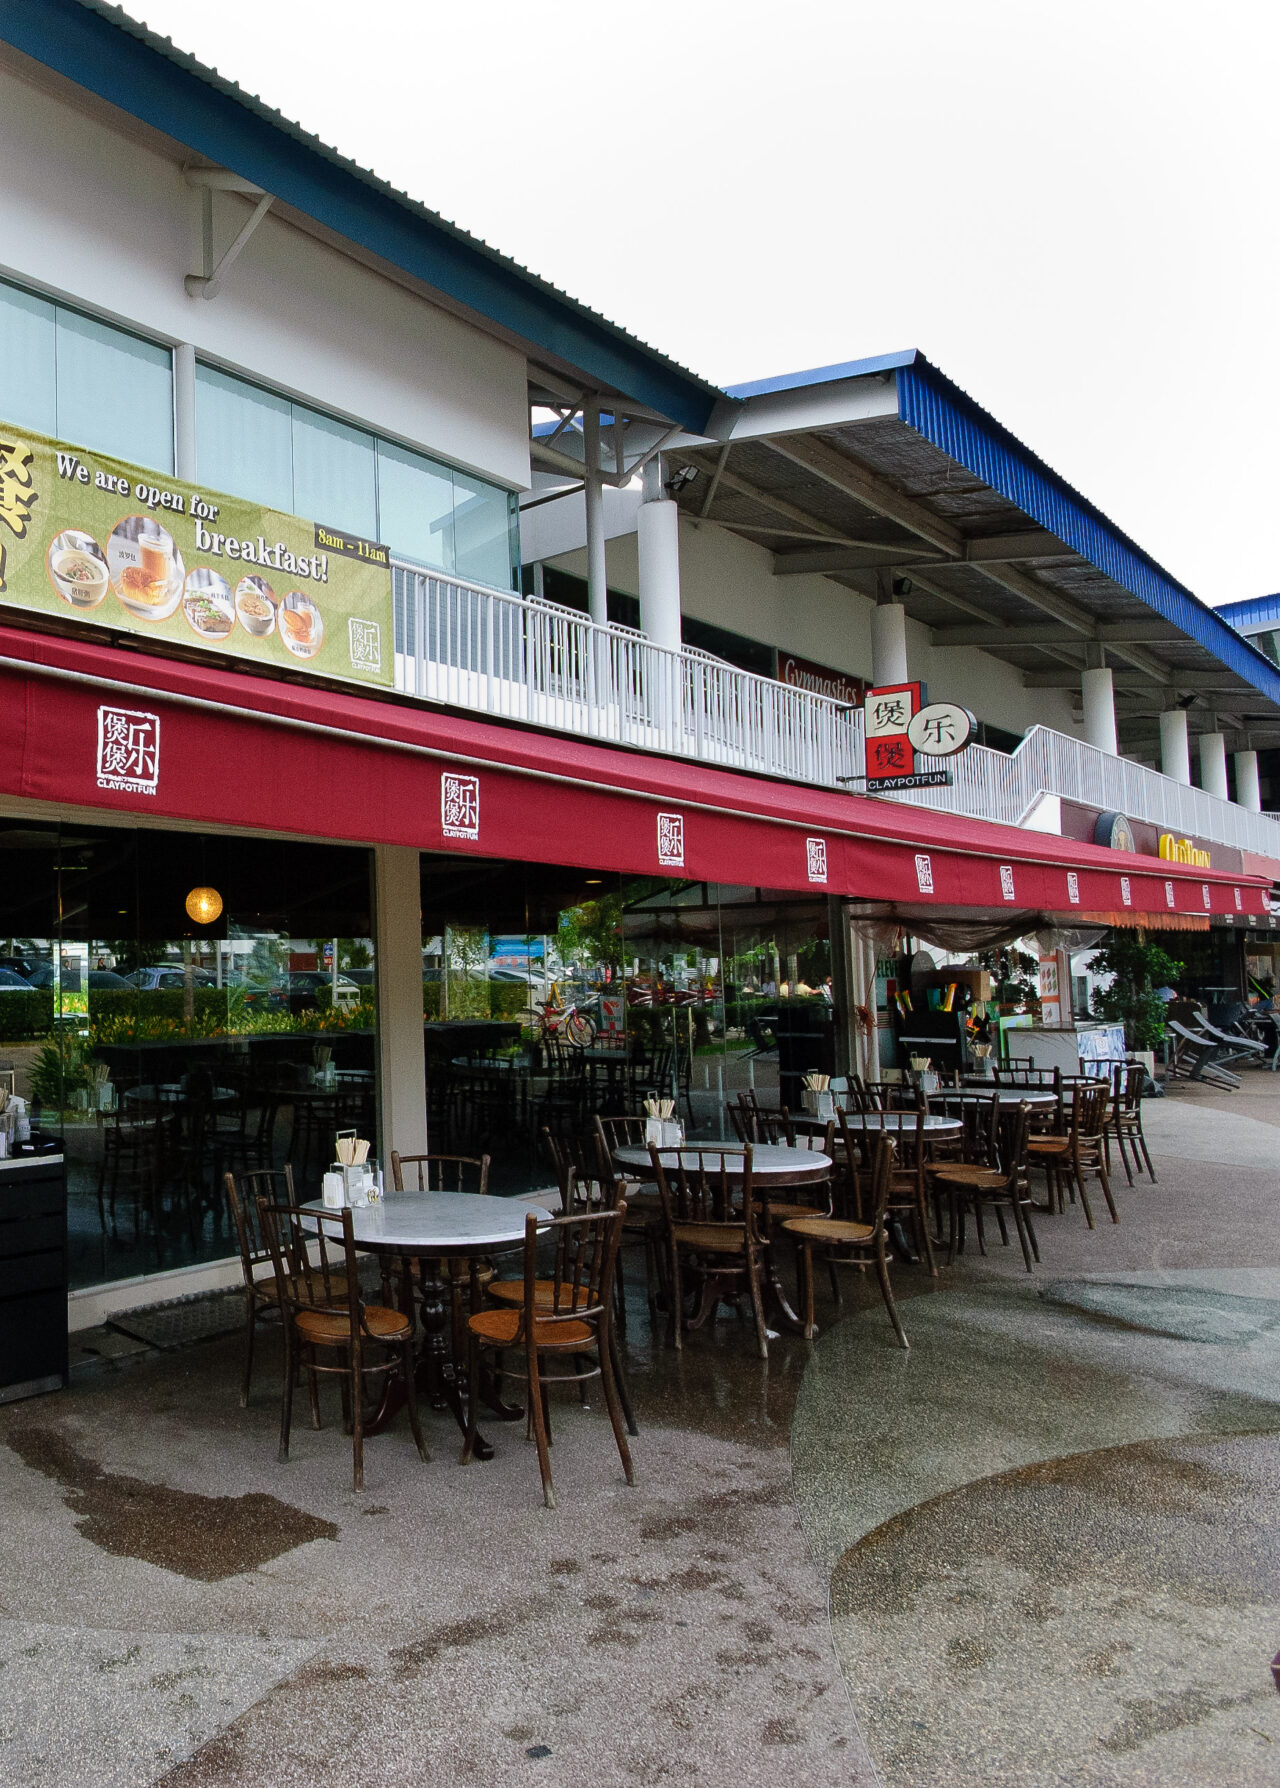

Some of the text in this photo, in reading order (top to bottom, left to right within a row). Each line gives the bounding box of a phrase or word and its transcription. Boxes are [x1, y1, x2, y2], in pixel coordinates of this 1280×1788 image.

[56, 451, 219, 521] We are open for
[195, 519, 328, 582] breakfast!
[318, 529, 344, 550] 8am
[358, 541, 387, 563] 11am
[785, 659, 857, 706] Gymnastics
[96, 778, 157, 796] CLAYPOTFUN
[868, 774, 947, 790] CLAYPOTFUN
